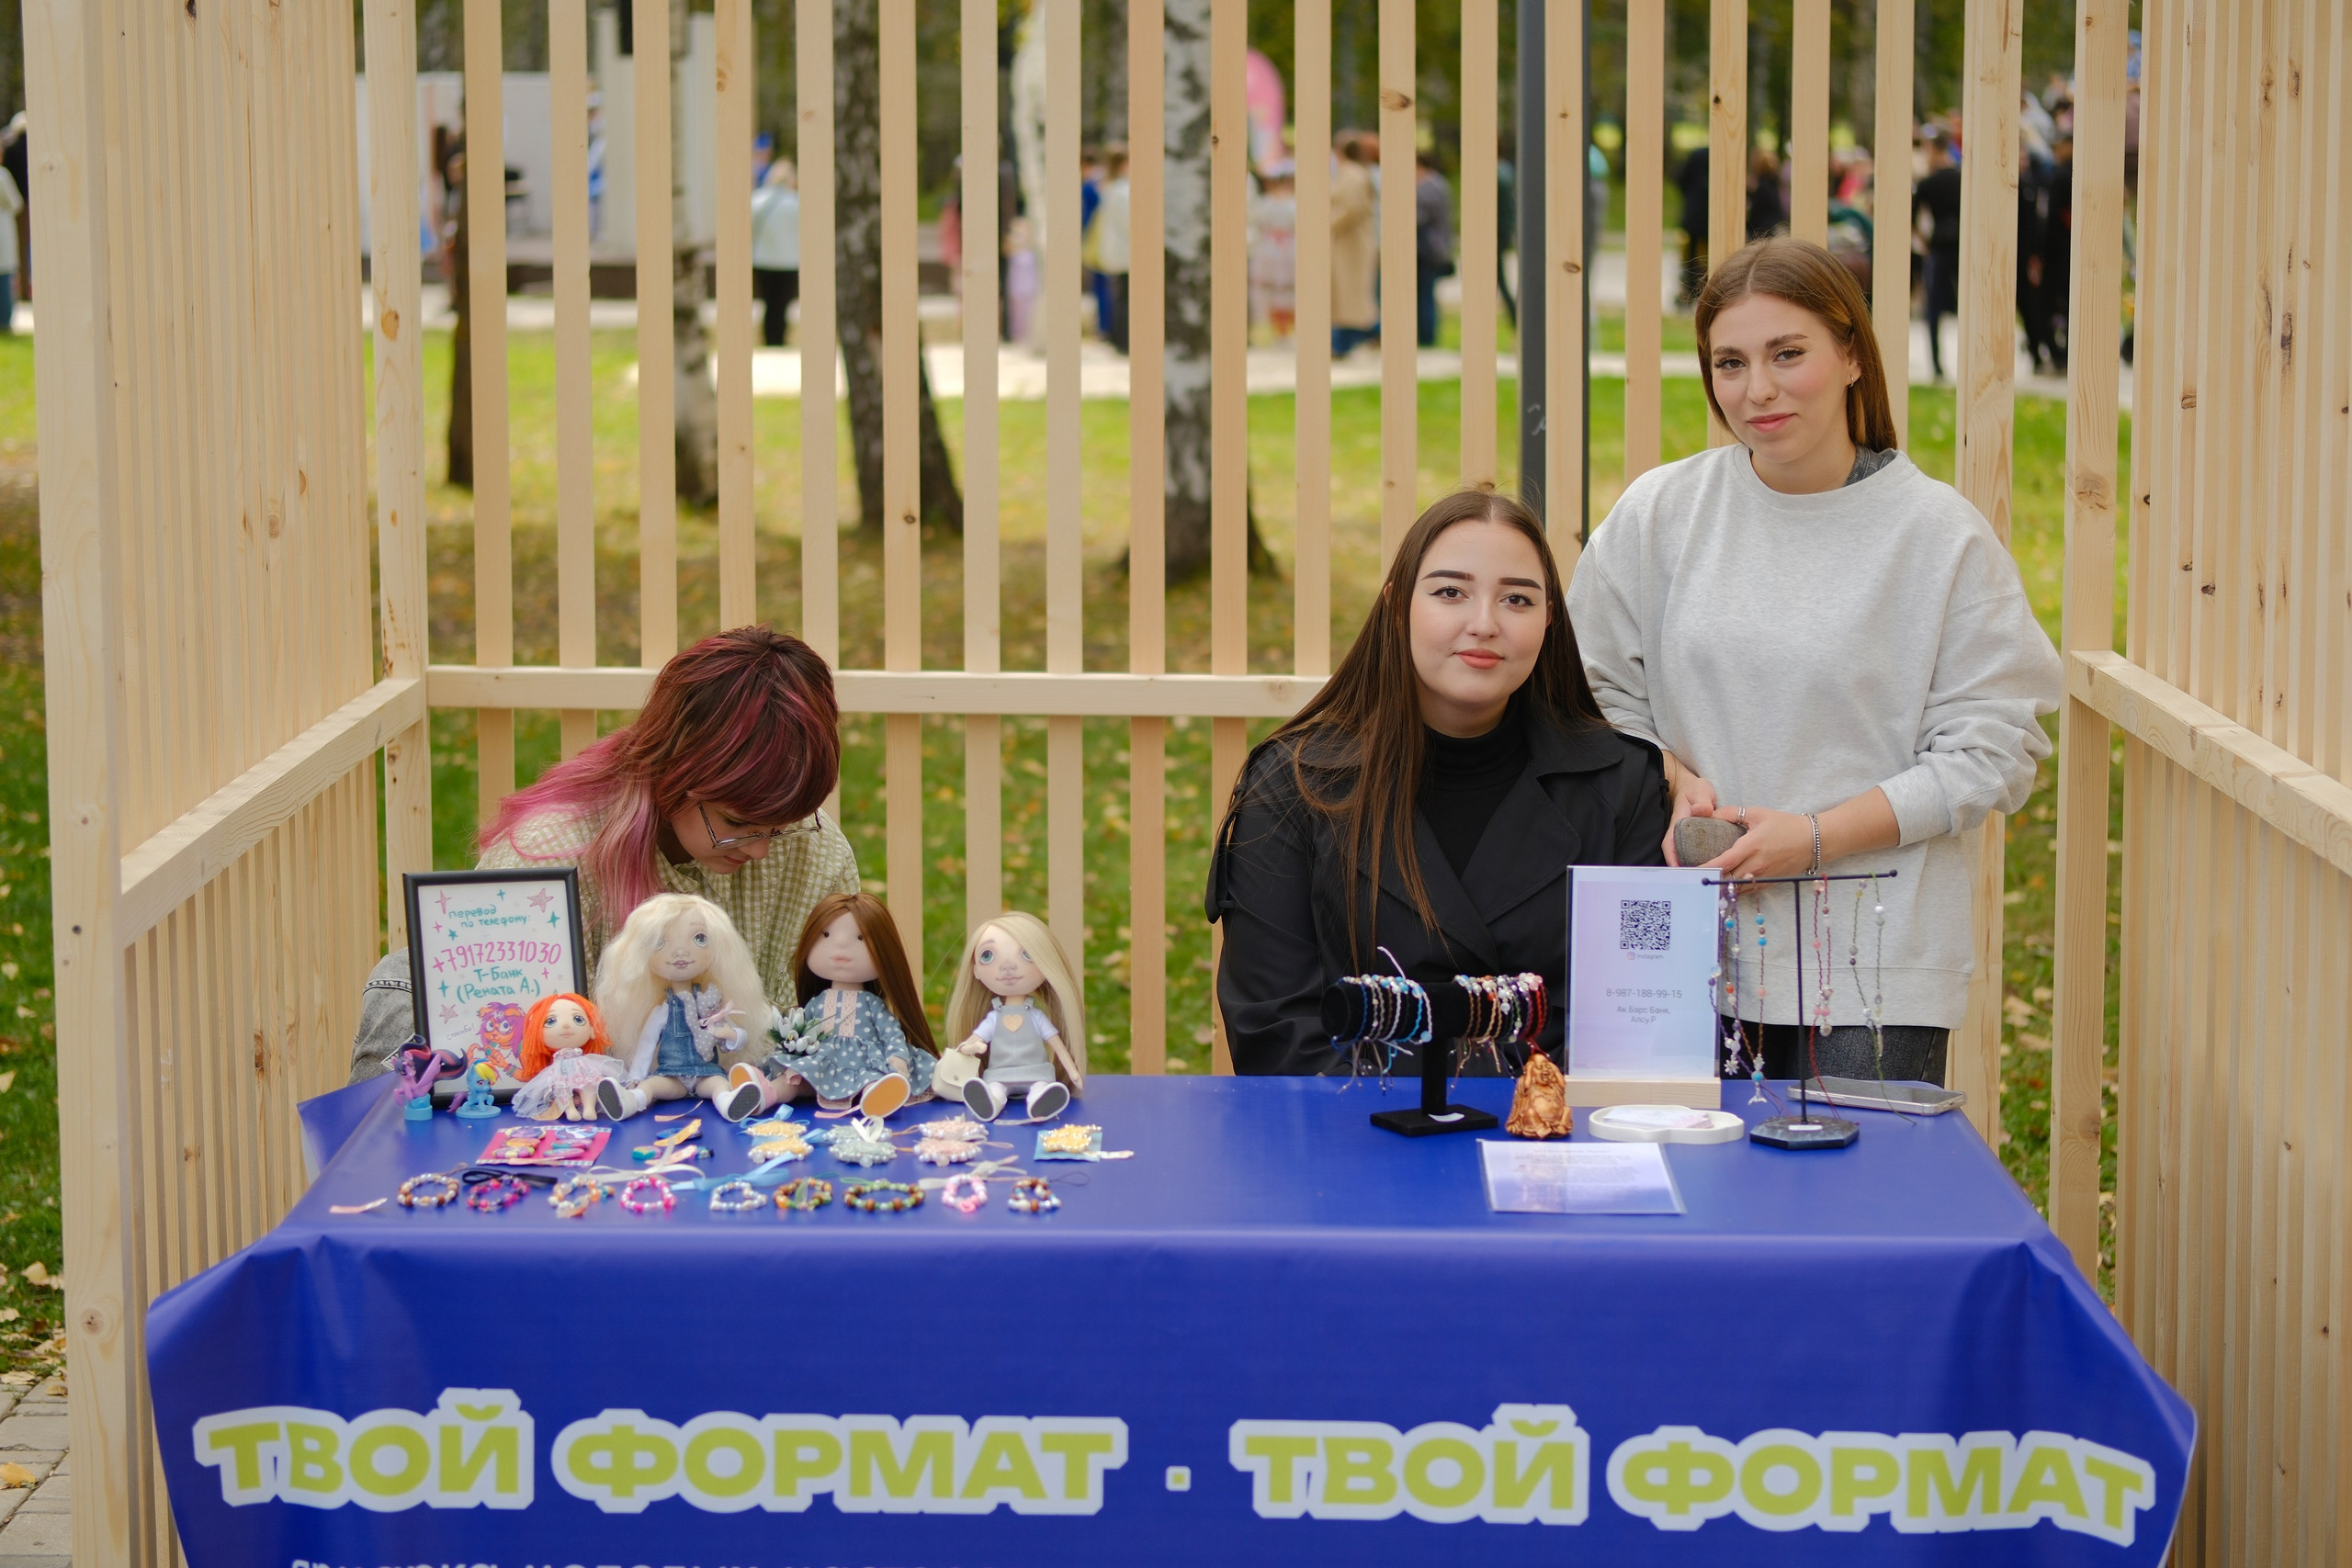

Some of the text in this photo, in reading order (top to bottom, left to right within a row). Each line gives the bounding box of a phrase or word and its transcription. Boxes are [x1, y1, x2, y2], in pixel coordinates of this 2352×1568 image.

[448, 904, 497, 919] перевод
[432, 940, 561, 973] +79172331030
[473, 966, 524, 983] Т-Банк
[457, 976, 541, 1004] (Рената А.)
[1606, 987, 1682, 998] 8-987-188-99-15
[1628, 1006, 1648, 1014] Барс
[205, 1401, 2146, 1532] ТВОЙ ФОРМАТ ТВОЙ ФОРМАТ
